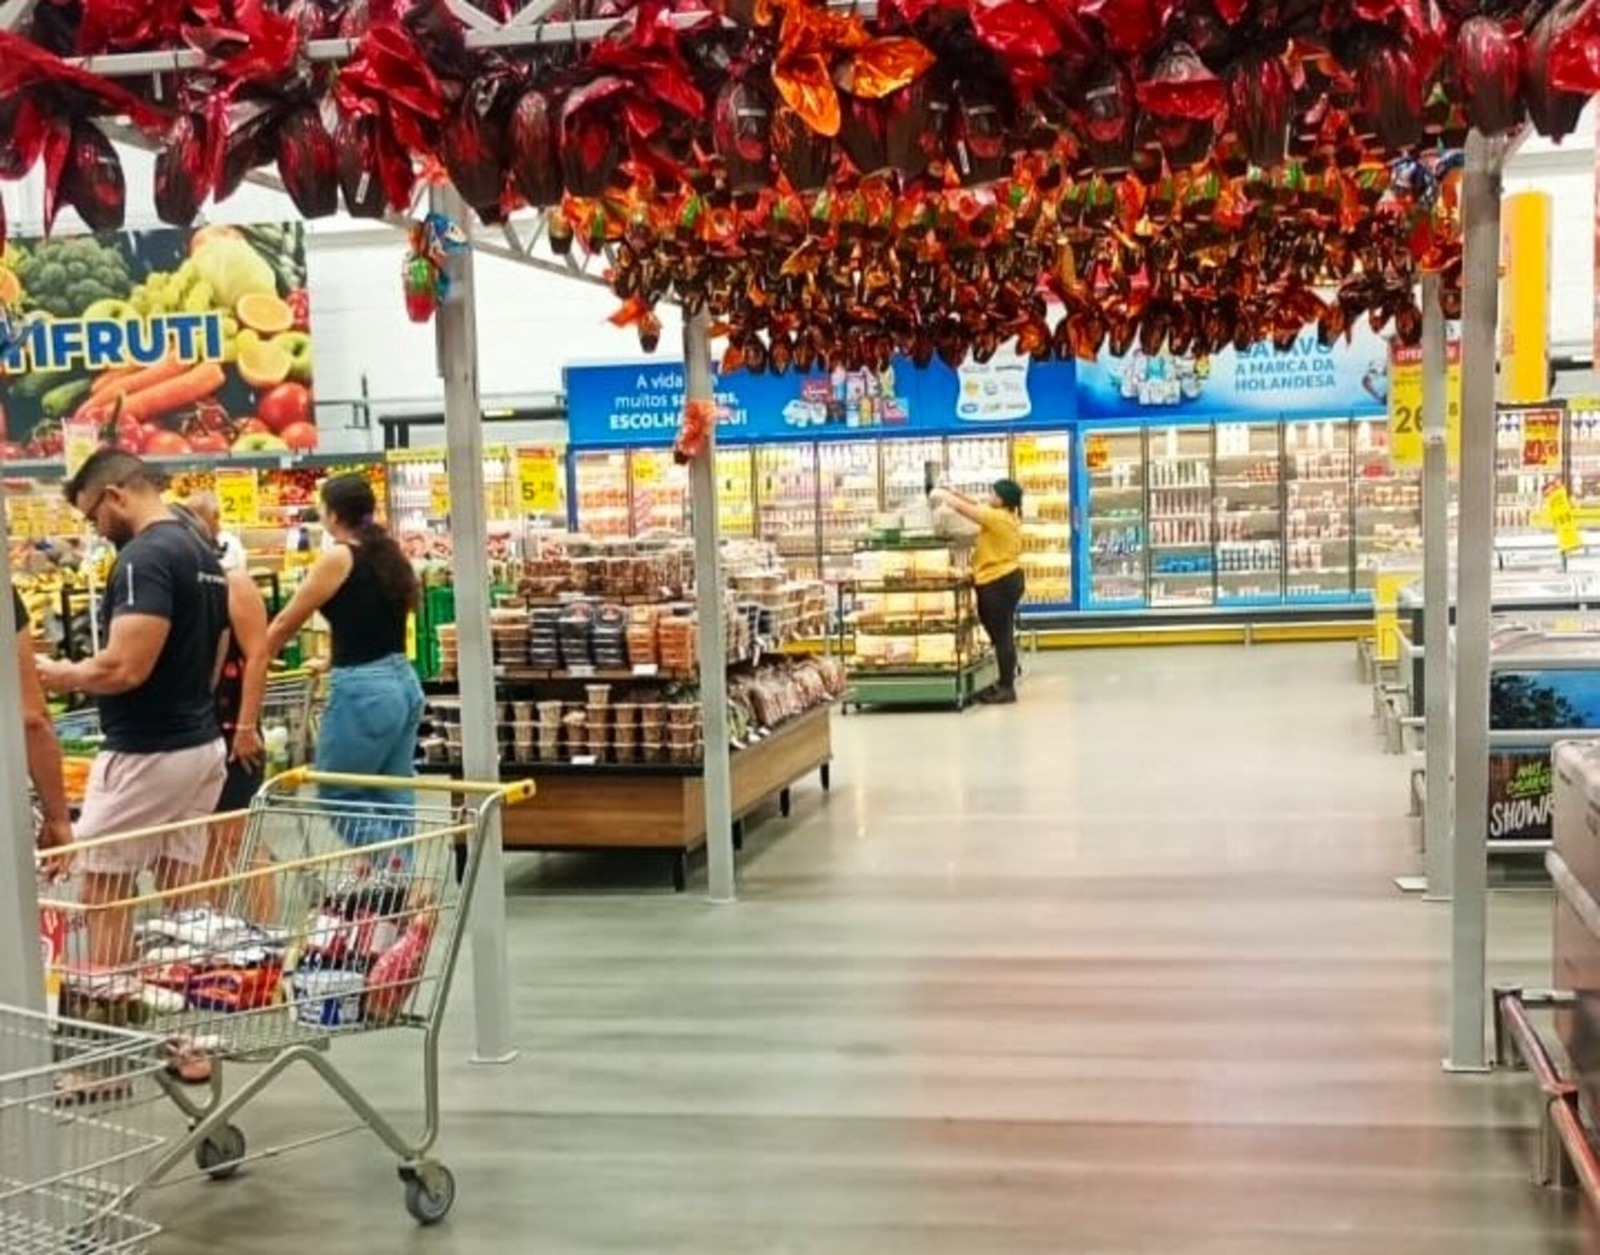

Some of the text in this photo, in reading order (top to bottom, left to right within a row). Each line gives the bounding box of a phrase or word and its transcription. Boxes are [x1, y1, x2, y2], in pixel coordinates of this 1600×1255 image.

[1236, 358, 1335, 374] A MARCA DA
[637, 373, 648, 389] A
[1235, 374, 1336, 391] HOLANDESA
[615, 395, 667, 409] muitos
